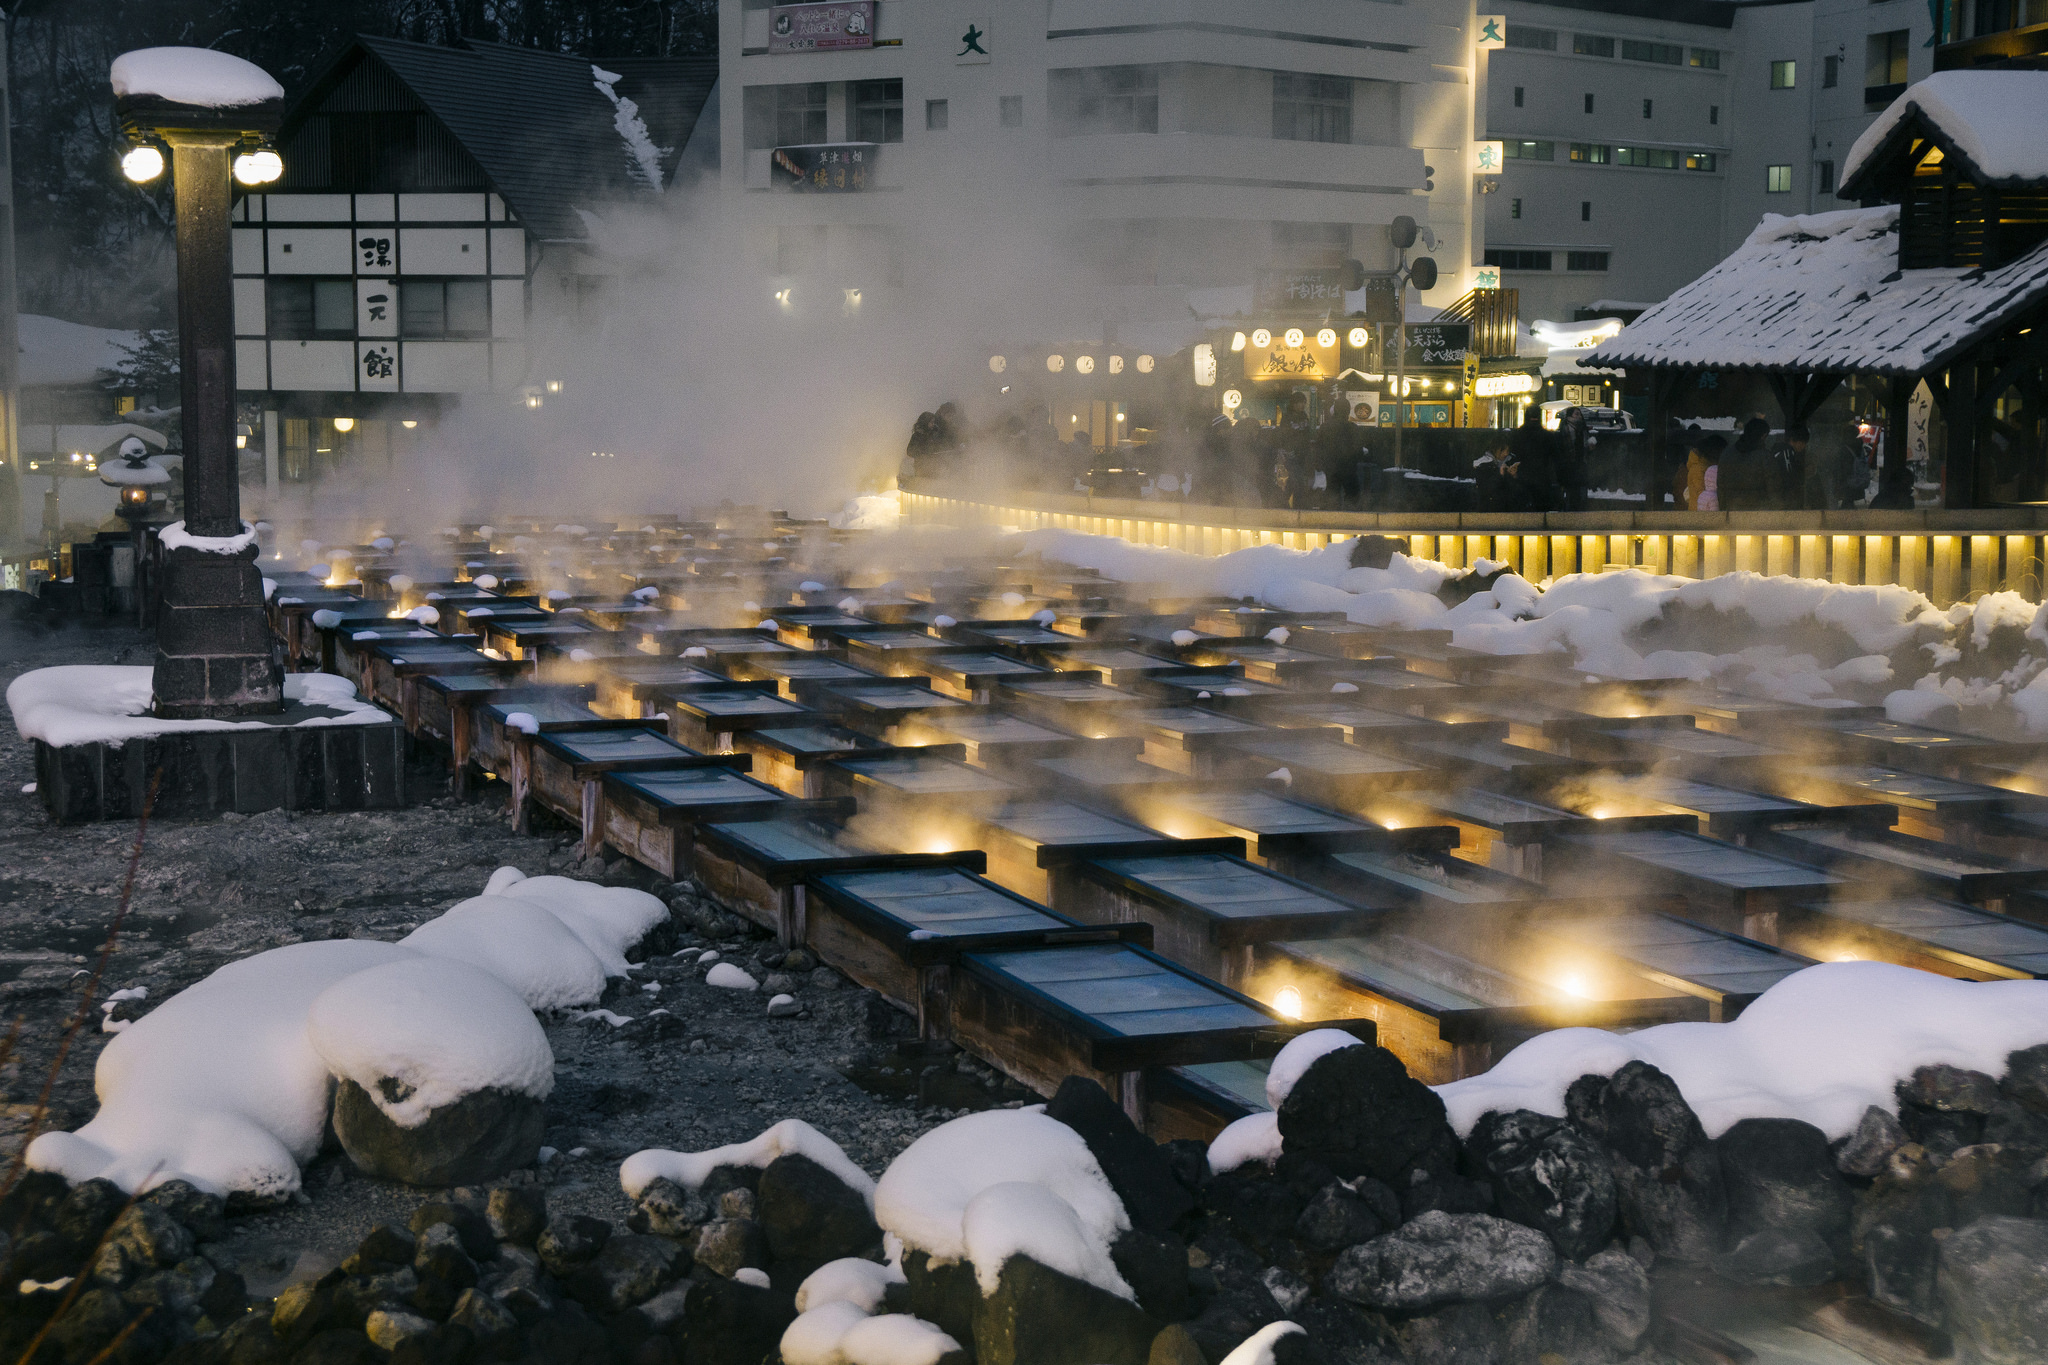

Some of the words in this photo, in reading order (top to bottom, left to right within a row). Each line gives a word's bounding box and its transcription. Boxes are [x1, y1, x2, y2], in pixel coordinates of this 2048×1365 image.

[957, 24, 988, 56] 大
[1286, 283, 1342, 299] 十割そば
[359, 237, 393, 378] 湯元館
[1413, 334, 1446, 347] 天ぷら
[1422, 347, 1467, 362] 食べ放題
